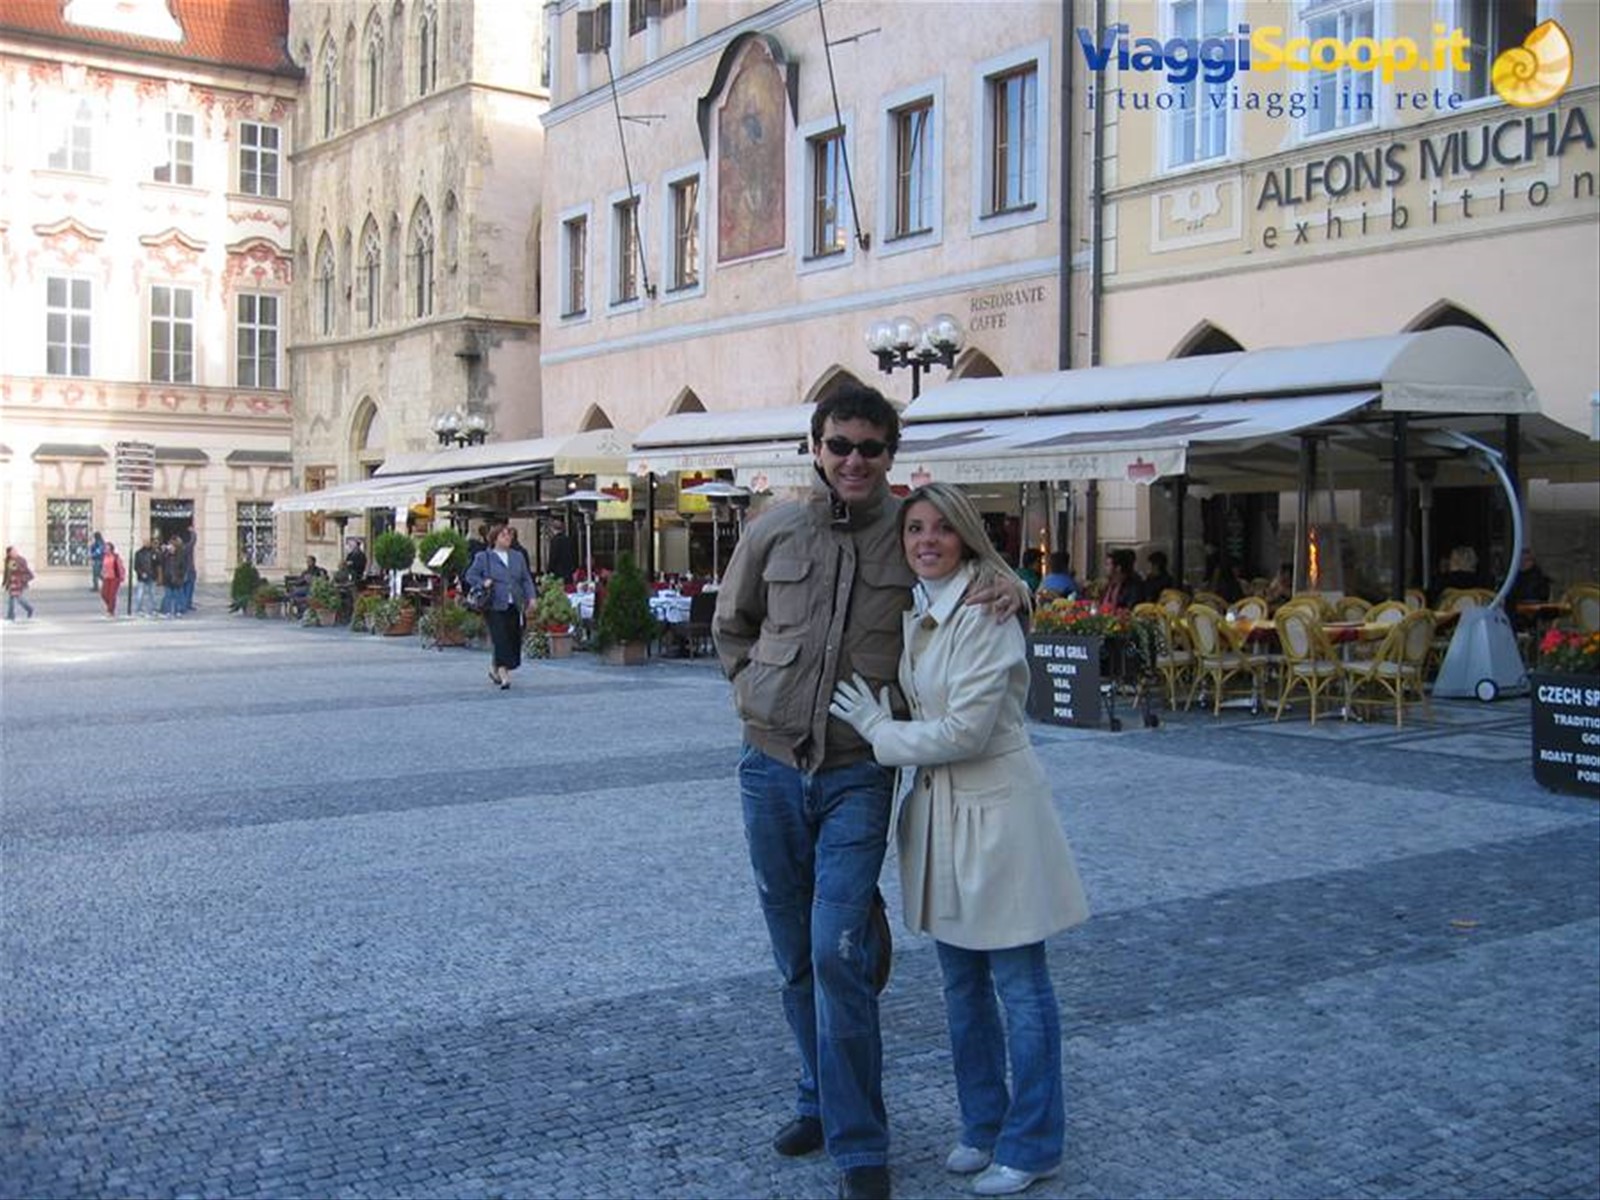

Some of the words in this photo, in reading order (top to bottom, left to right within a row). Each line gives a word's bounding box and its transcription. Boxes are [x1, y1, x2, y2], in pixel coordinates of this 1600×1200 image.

[1257, 141, 1407, 211] ALFONS
[1419, 105, 1596, 181] MUCHA
[1262, 168, 1597, 249] exhibition
[970, 286, 1046, 311] RISTORANTE
[969, 312, 1007, 332] CAFFE
[1054, 644, 1065, 658] ON
[1066, 645, 1088, 660] GRILL
[1046, 663, 1076, 674] CHICKEN
[1538, 685, 1582, 705] CZECH
[1540, 748, 1573, 763] ROAST
